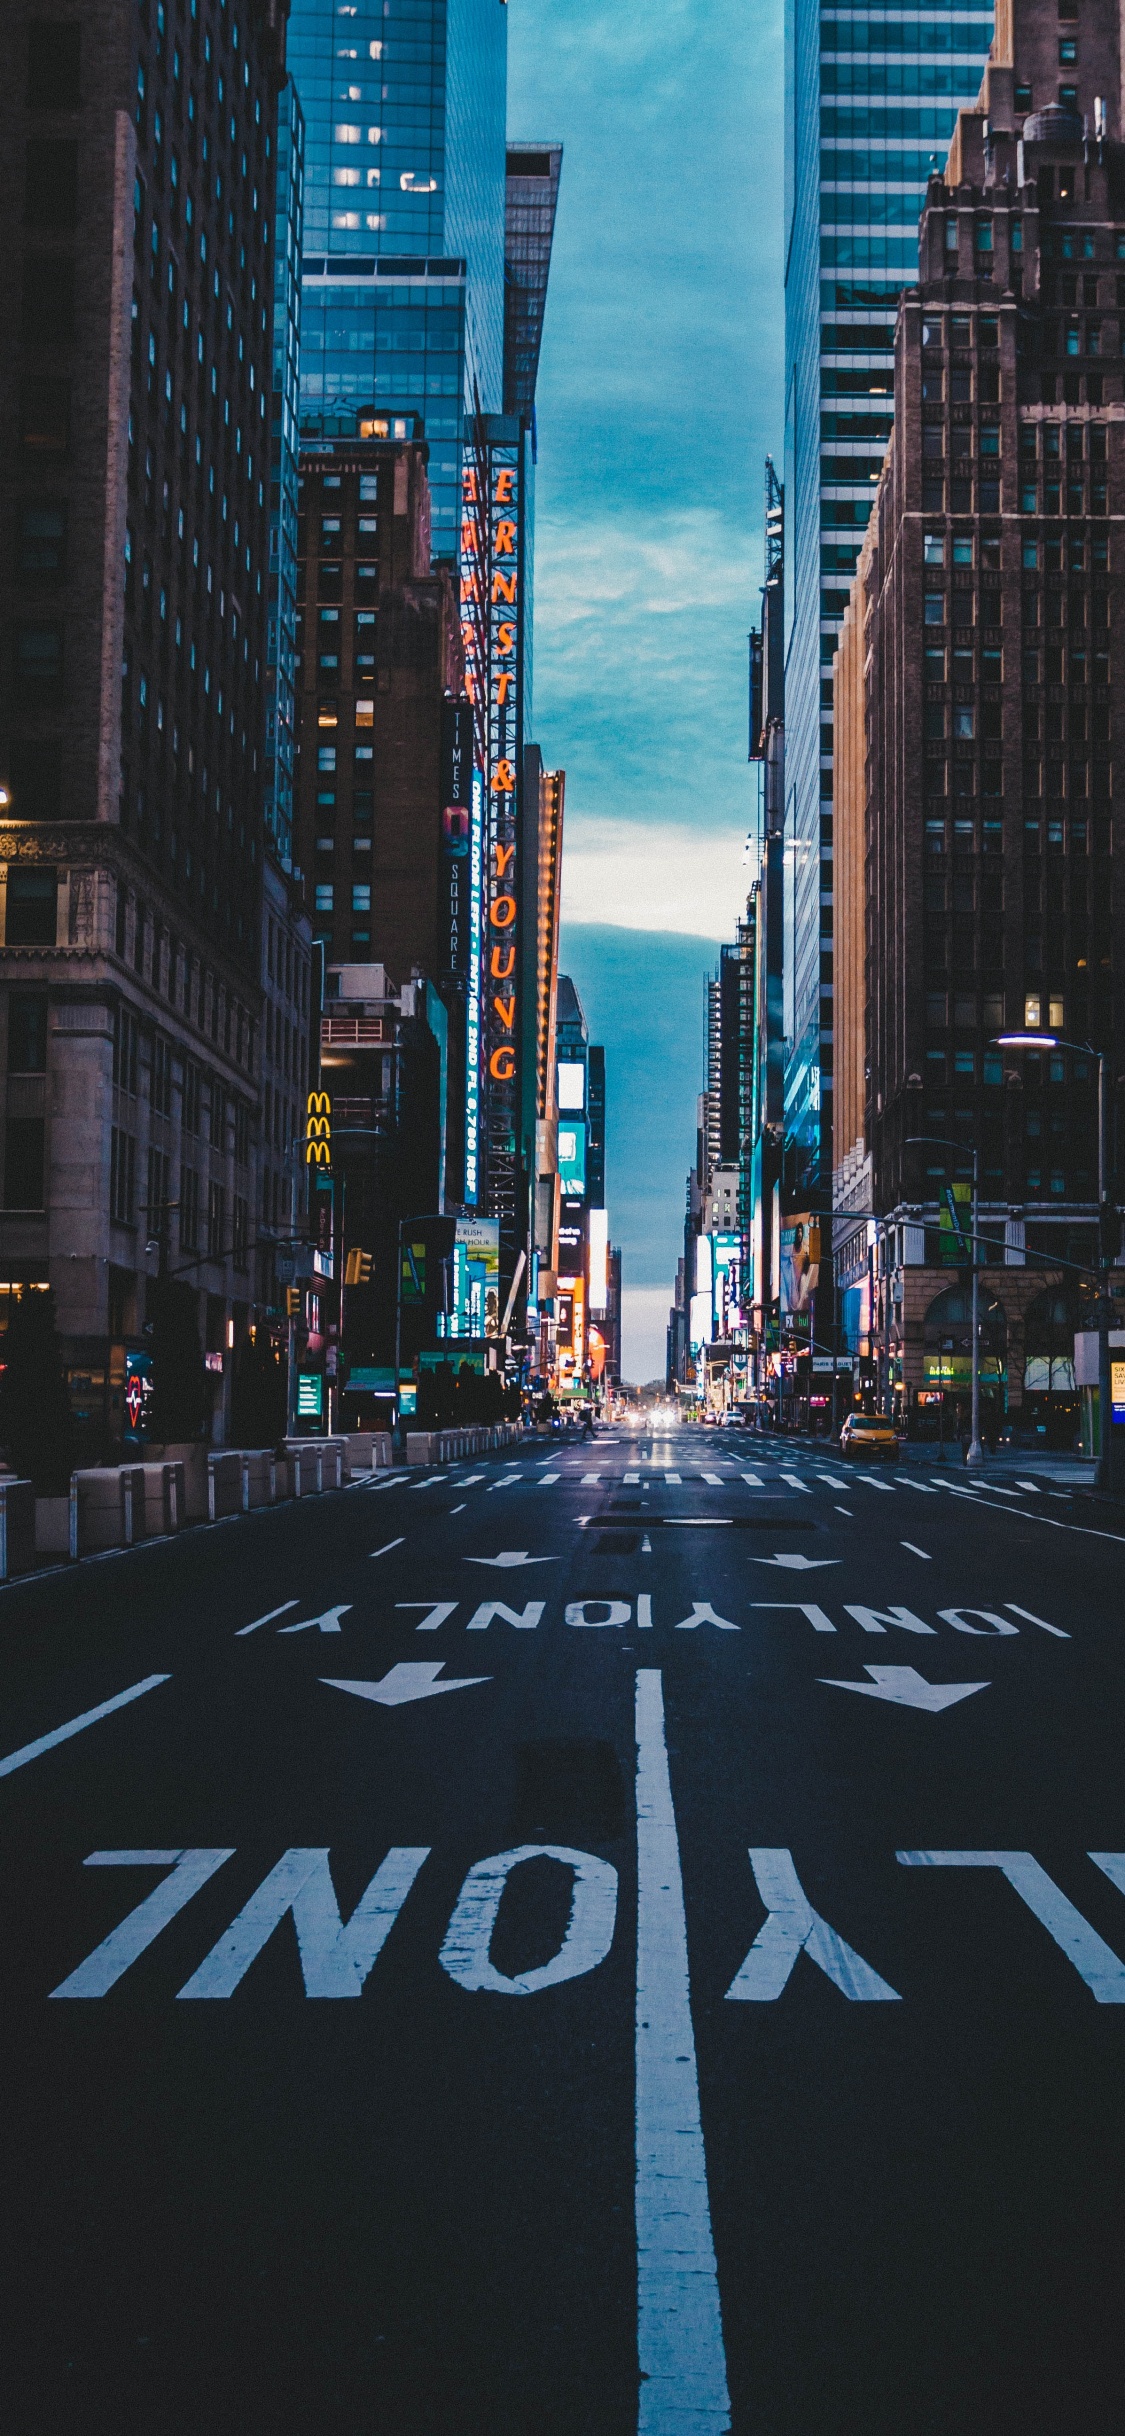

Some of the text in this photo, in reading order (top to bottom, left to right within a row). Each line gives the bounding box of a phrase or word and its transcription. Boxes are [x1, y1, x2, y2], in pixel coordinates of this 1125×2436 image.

[451, 711, 462, 799] TIMES
[489, 469, 517, 1080] ERNST & YOUNG
[471, 780, 481, 822] ONE
[471, 824, 480, 886] FLOOR
[449, 864, 460, 970] SQUARE
[470, 890, 479, 938] LEFT
[468, 953, 479, 1022] ENTIRE
[468, 1026, 478, 1066] 2ND
[467, 1070, 478, 1092] FL
[463, 1228, 483, 1237] RUSH
[468, 1238, 490, 1246] HOUR
[785, 1314, 795, 1329] FX
[798, 1314, 809, 1328] hul
[276, 1599, 632, 1635] ONLY
[674, 1602, 1021, 1637] ONLY
[47, 1844, 619, 2000] ONL
[723, 1847, 1125, 2004] LY
